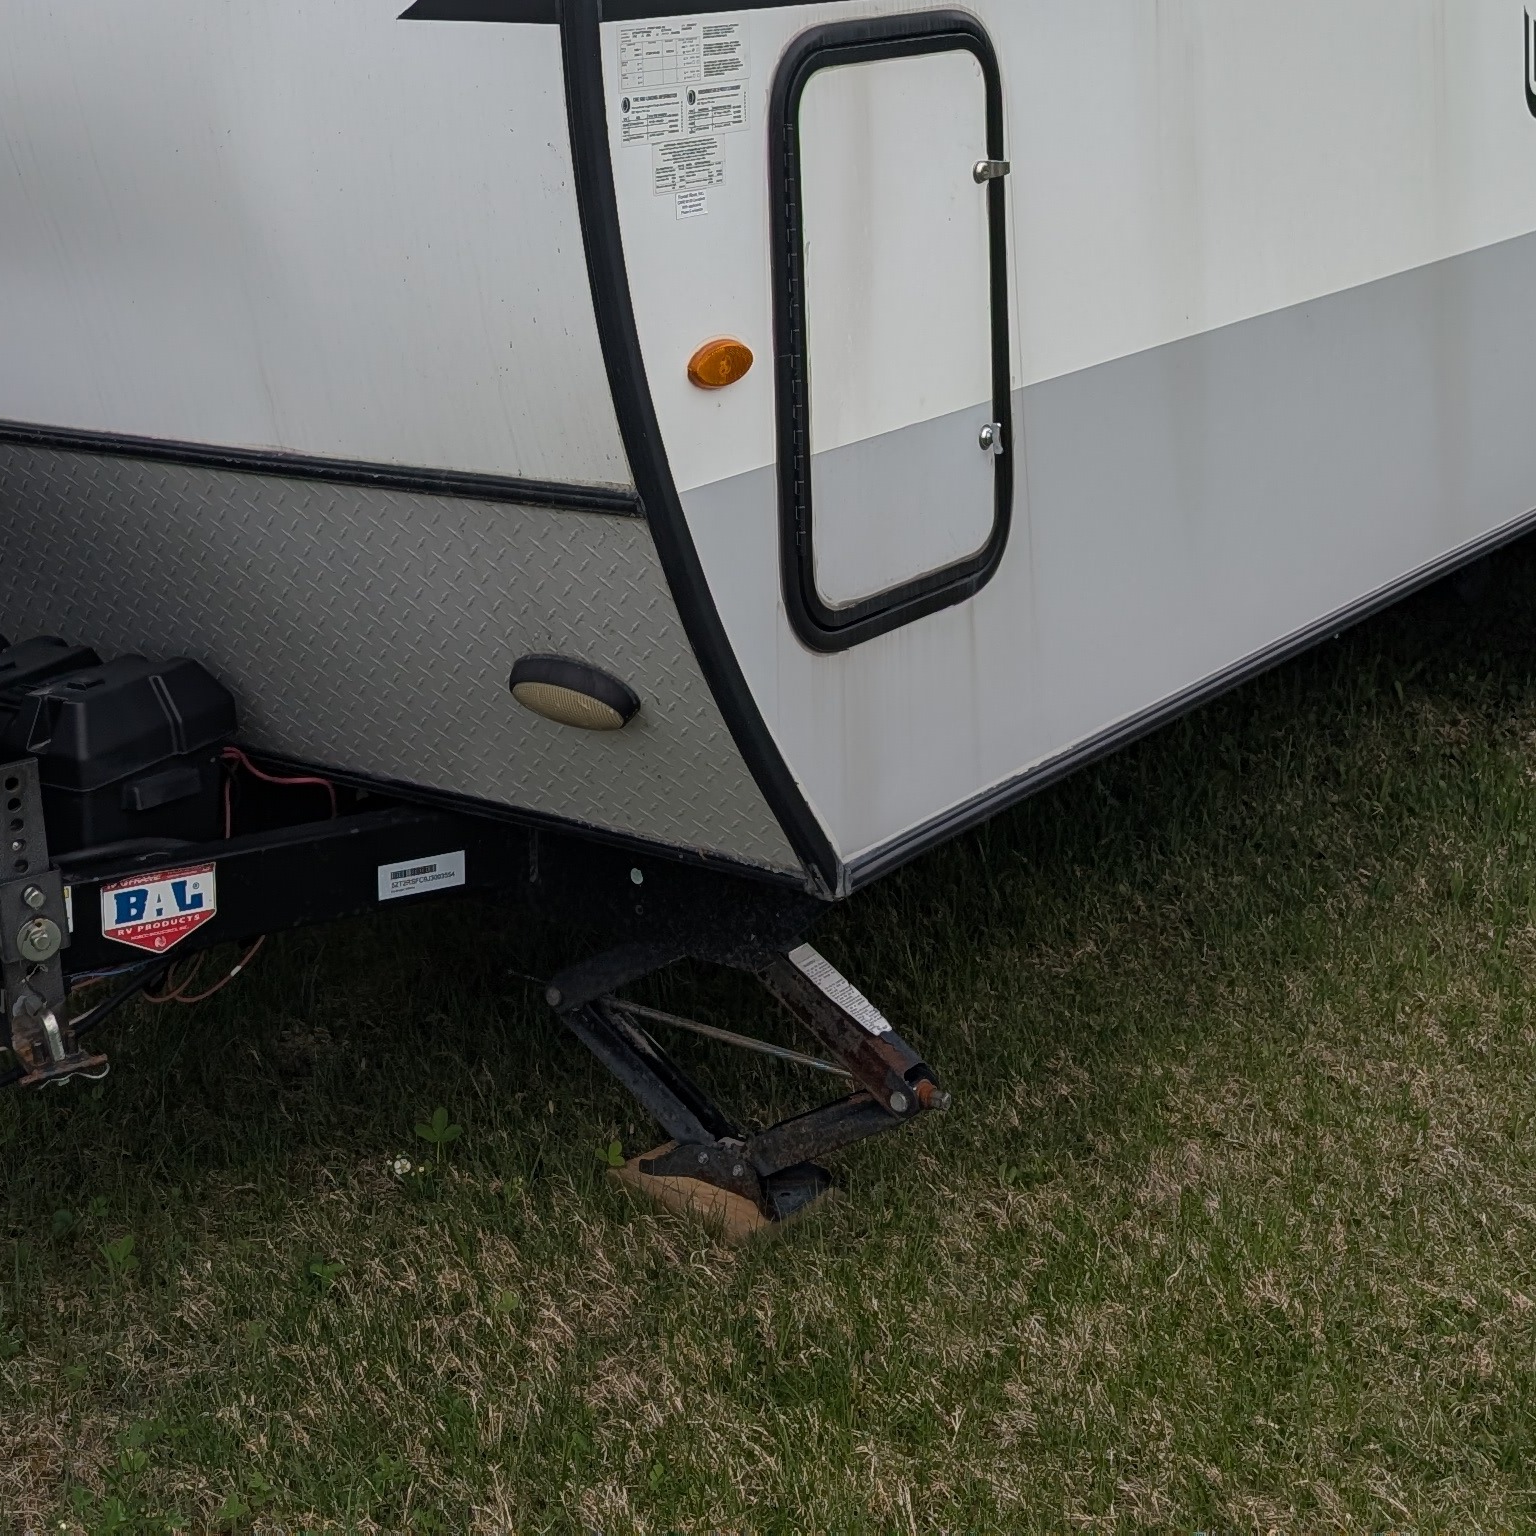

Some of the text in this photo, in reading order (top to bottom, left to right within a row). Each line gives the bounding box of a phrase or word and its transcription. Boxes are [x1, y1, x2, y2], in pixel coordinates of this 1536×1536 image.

[114, 880, 204, 925] BAL
[117, 914, 201, 936] RV PRODUCTS
